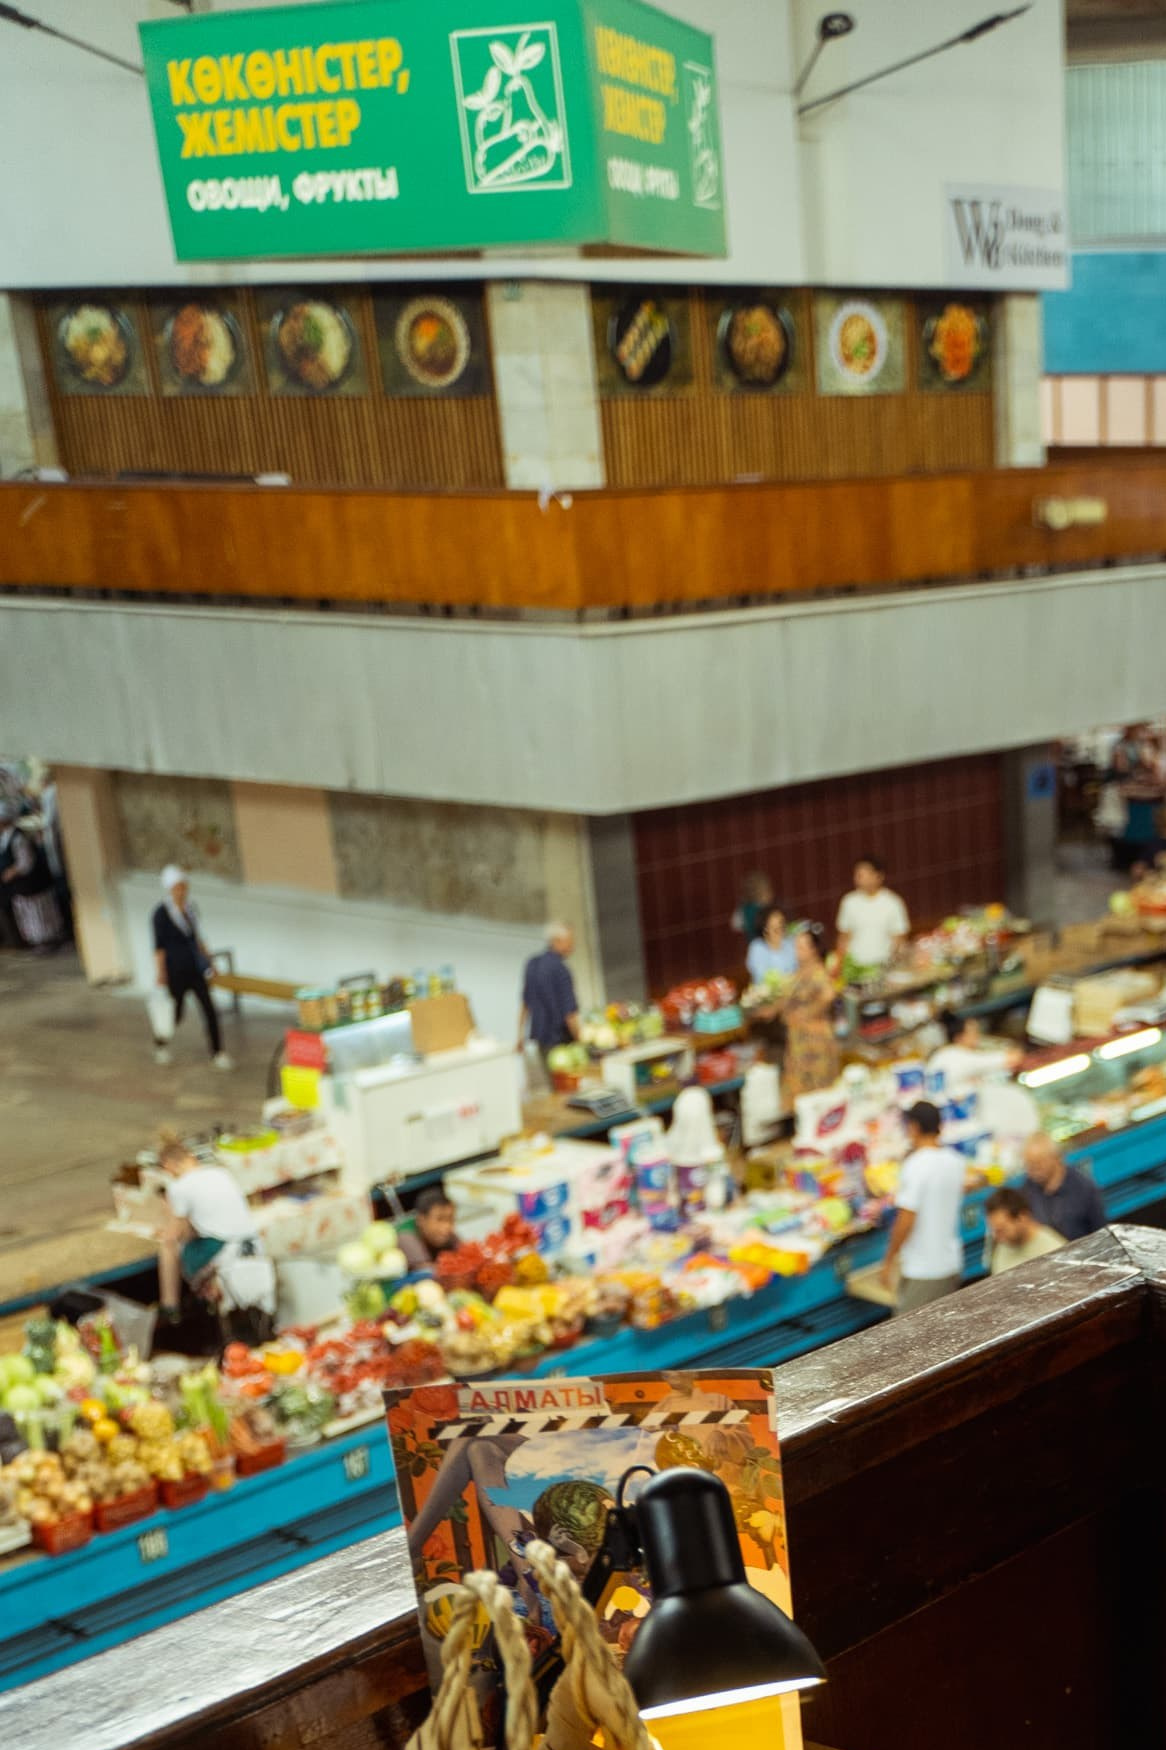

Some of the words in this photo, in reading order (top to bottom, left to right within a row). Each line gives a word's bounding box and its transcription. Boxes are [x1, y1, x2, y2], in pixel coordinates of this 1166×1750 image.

[167, 37, 410, 94] КӨКӨНІСТЕР,
[176, 97, 361, 158] ЖЕМІСТЕР
[186, 174, 289, 212] ОВОЩИ,
[292, 166, 399, 204] ФРУКТЫ
[469, 1385, 601, 1413] АЛМАТЫ
